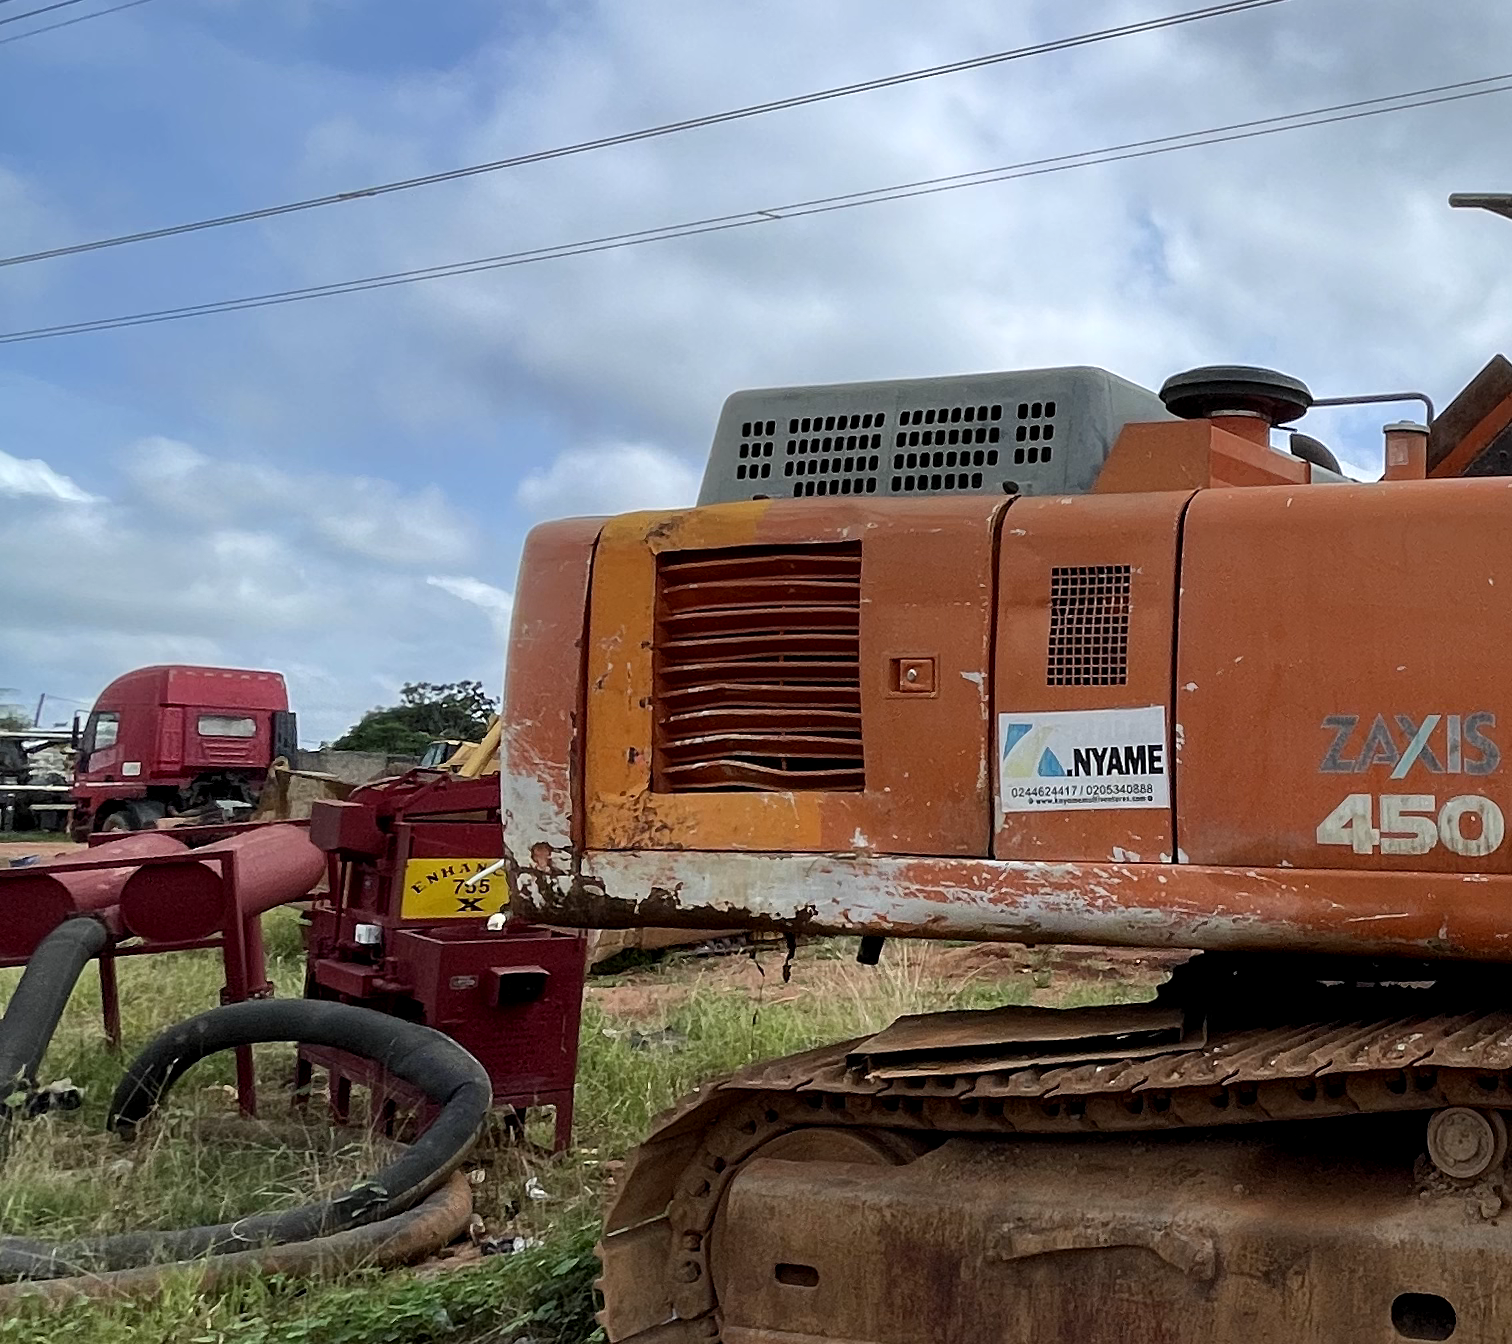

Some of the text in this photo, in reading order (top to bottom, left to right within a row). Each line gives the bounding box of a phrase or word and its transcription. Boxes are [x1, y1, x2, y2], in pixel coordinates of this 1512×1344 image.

[1319, 712, 1501, 779] ZAXIS
[1011, 785, 1078, 798] 0244624417
[1316, 793, 1505, 857] 450
